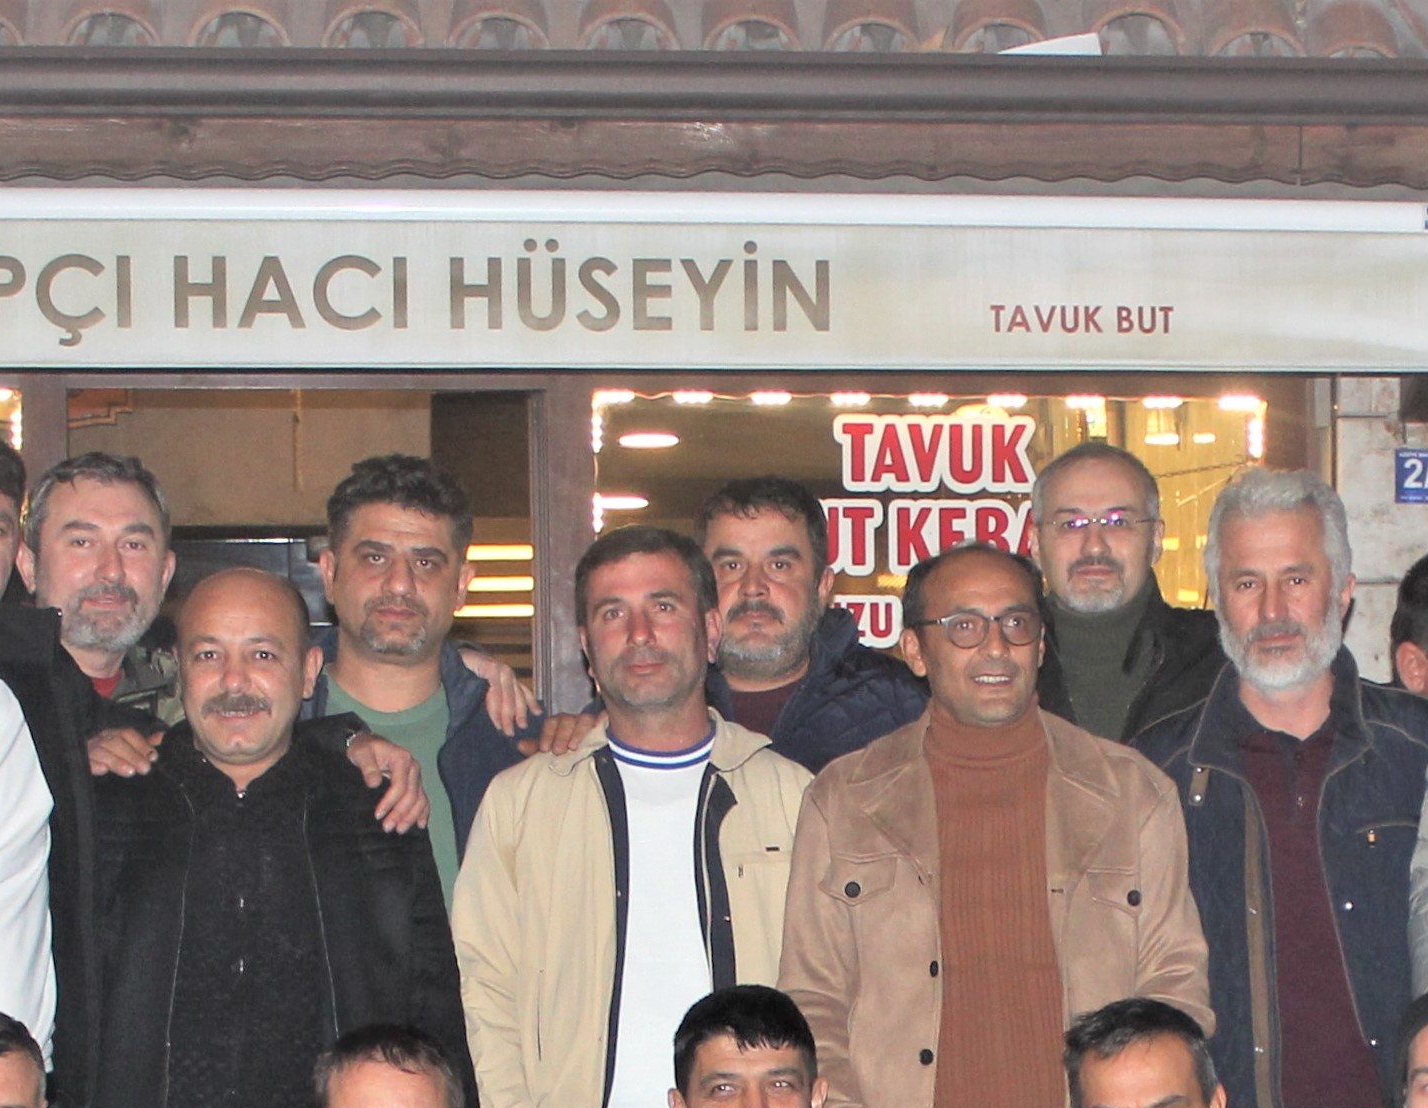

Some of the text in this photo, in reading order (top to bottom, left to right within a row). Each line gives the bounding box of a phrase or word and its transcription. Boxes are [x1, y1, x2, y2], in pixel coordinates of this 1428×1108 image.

[173, 254, 408, 331] HACI
[449, 238, 831, 333] HÜSEYİN
[990, 304, 1174, 334] TAVUK BUT
[842, 422, 1030, 484] TAVUK
